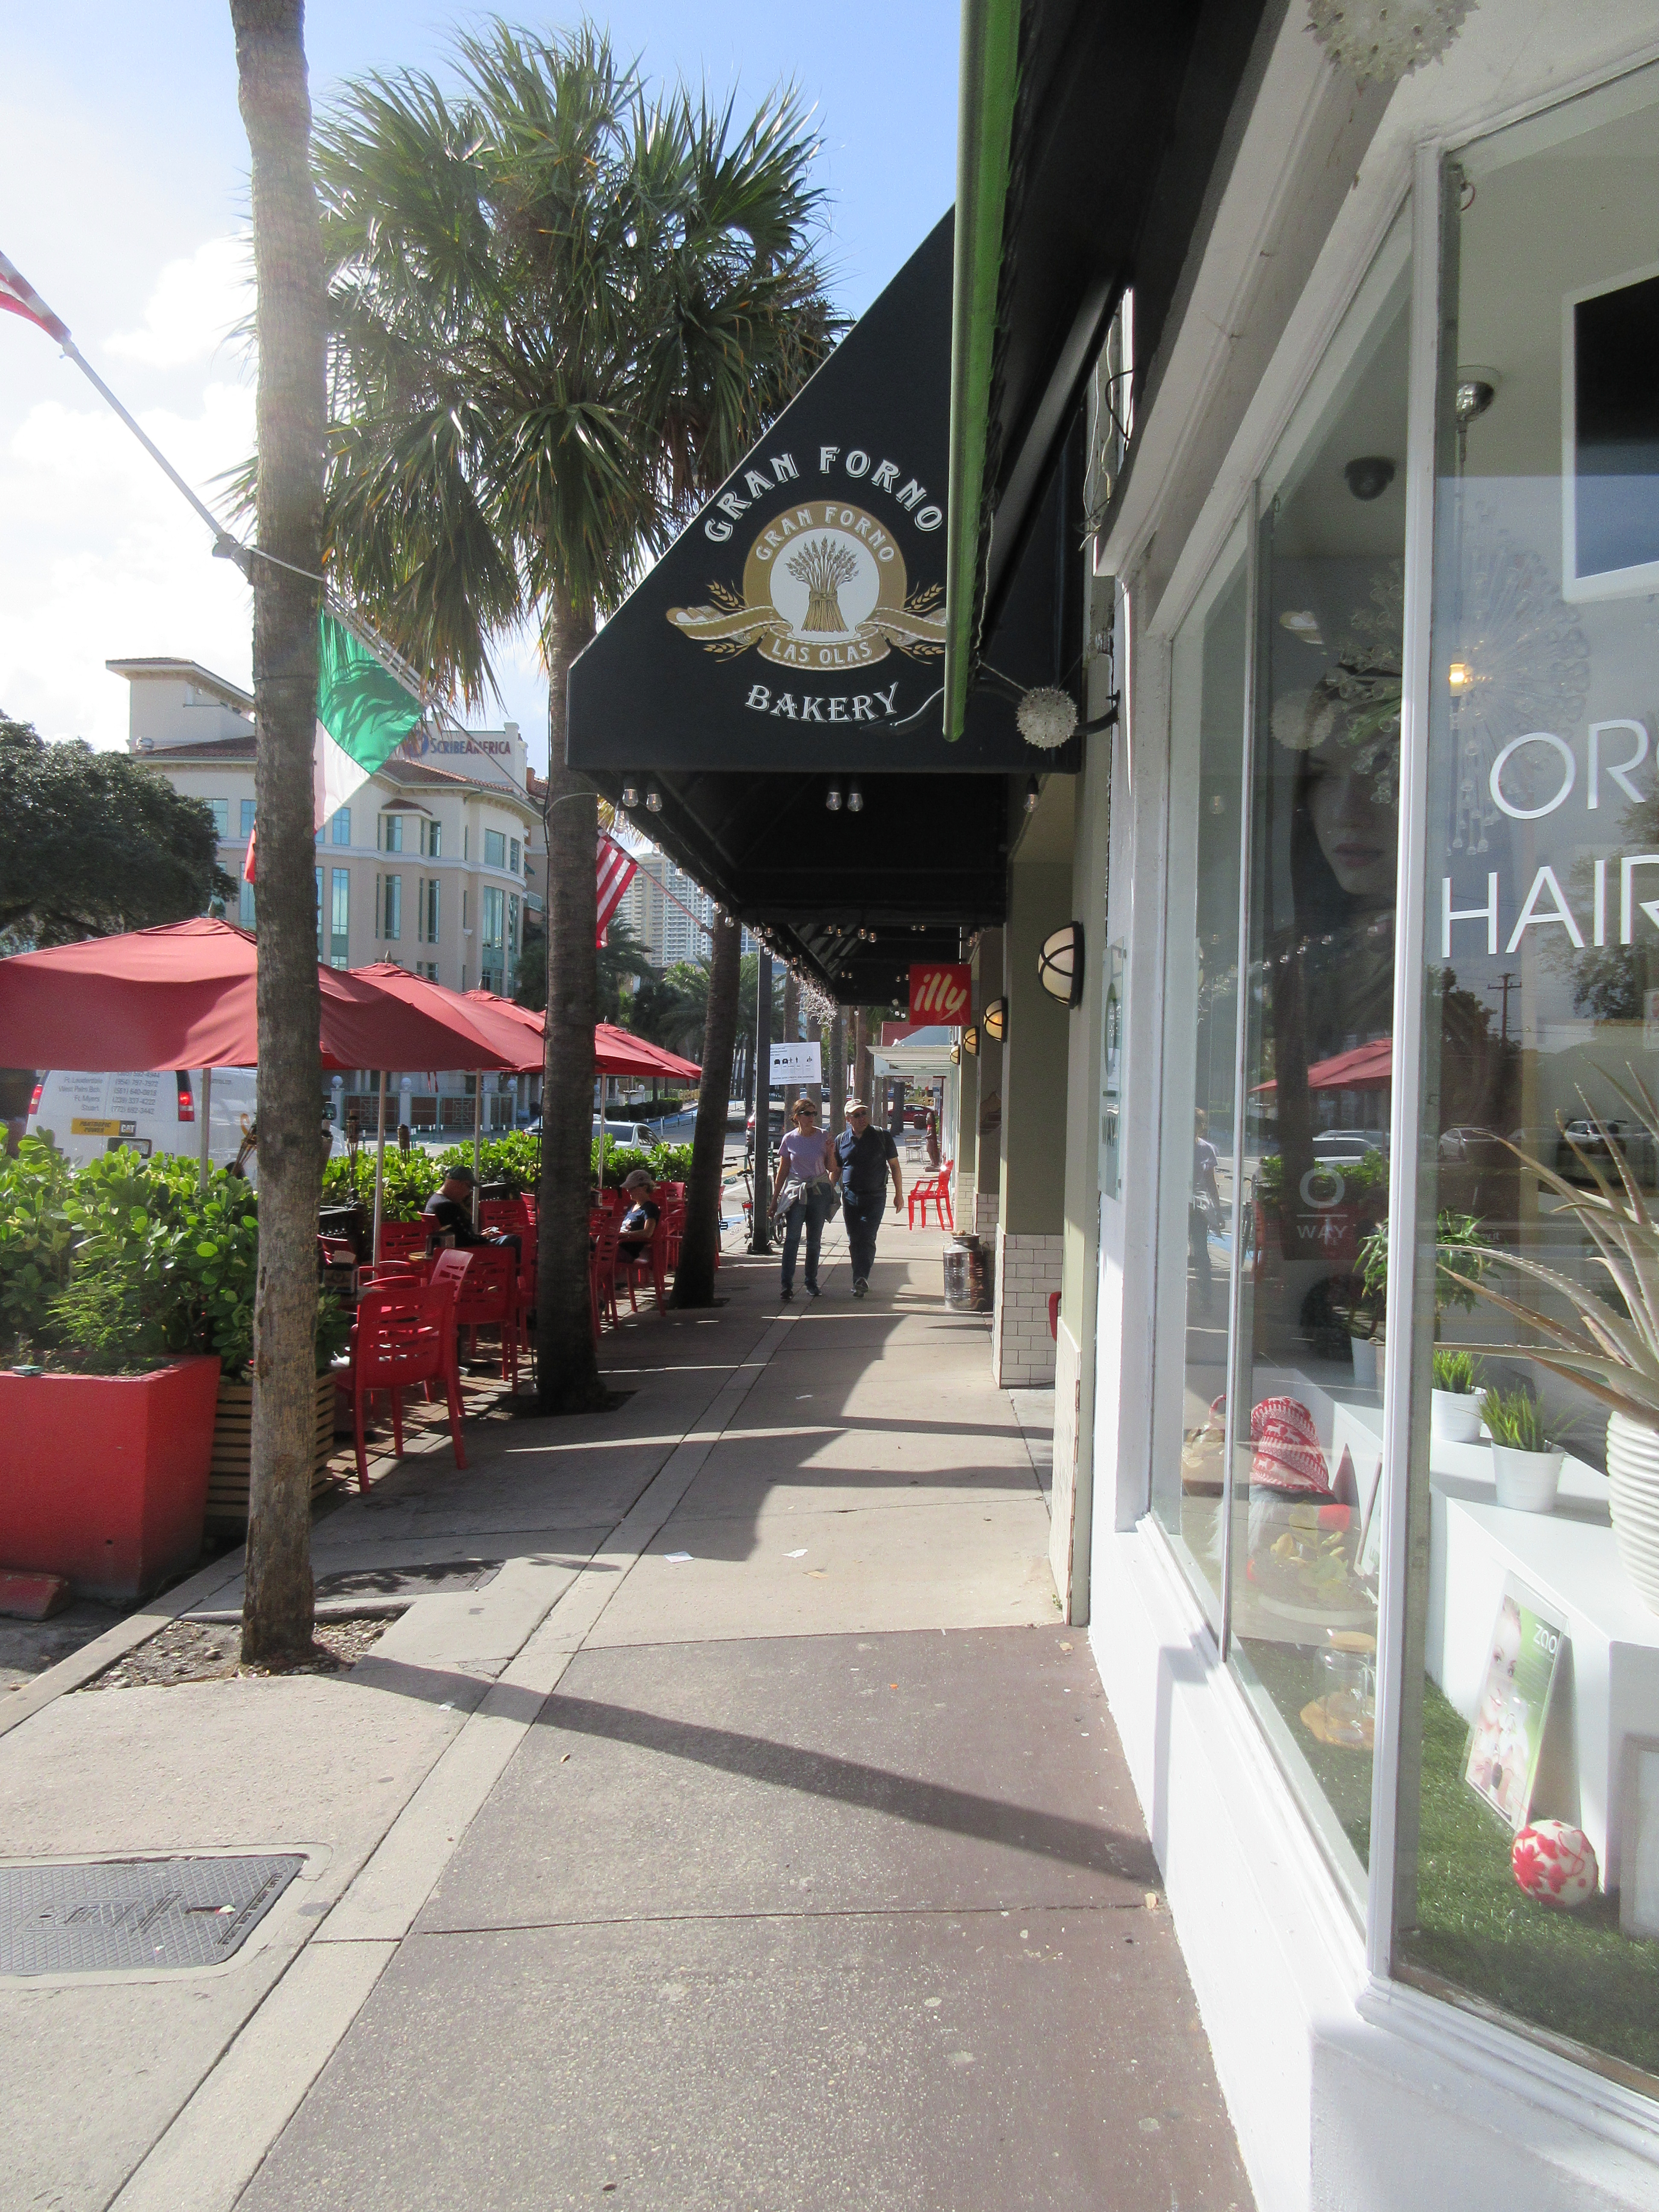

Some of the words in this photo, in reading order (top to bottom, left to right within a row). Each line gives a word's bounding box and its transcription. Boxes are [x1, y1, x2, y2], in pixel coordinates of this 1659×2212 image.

[705, 453, 800, 543] GRAN
[818, 446, 943, 532] FORNO
[755, 508, 813, 562] GRAN
[824, 506, 896, 562] FORNO
[772, 642, 810, 663] LAS
[819, 641, 873, 665] OLAS
[744, 682, 899, 723] BAKERY
[1489, 719, 1659, 819] OR
[914, 972, 967, 1021] illy
[121, 1124, 134, 1132] CAT
[1297, 1225, 1348, 1238] WAY
